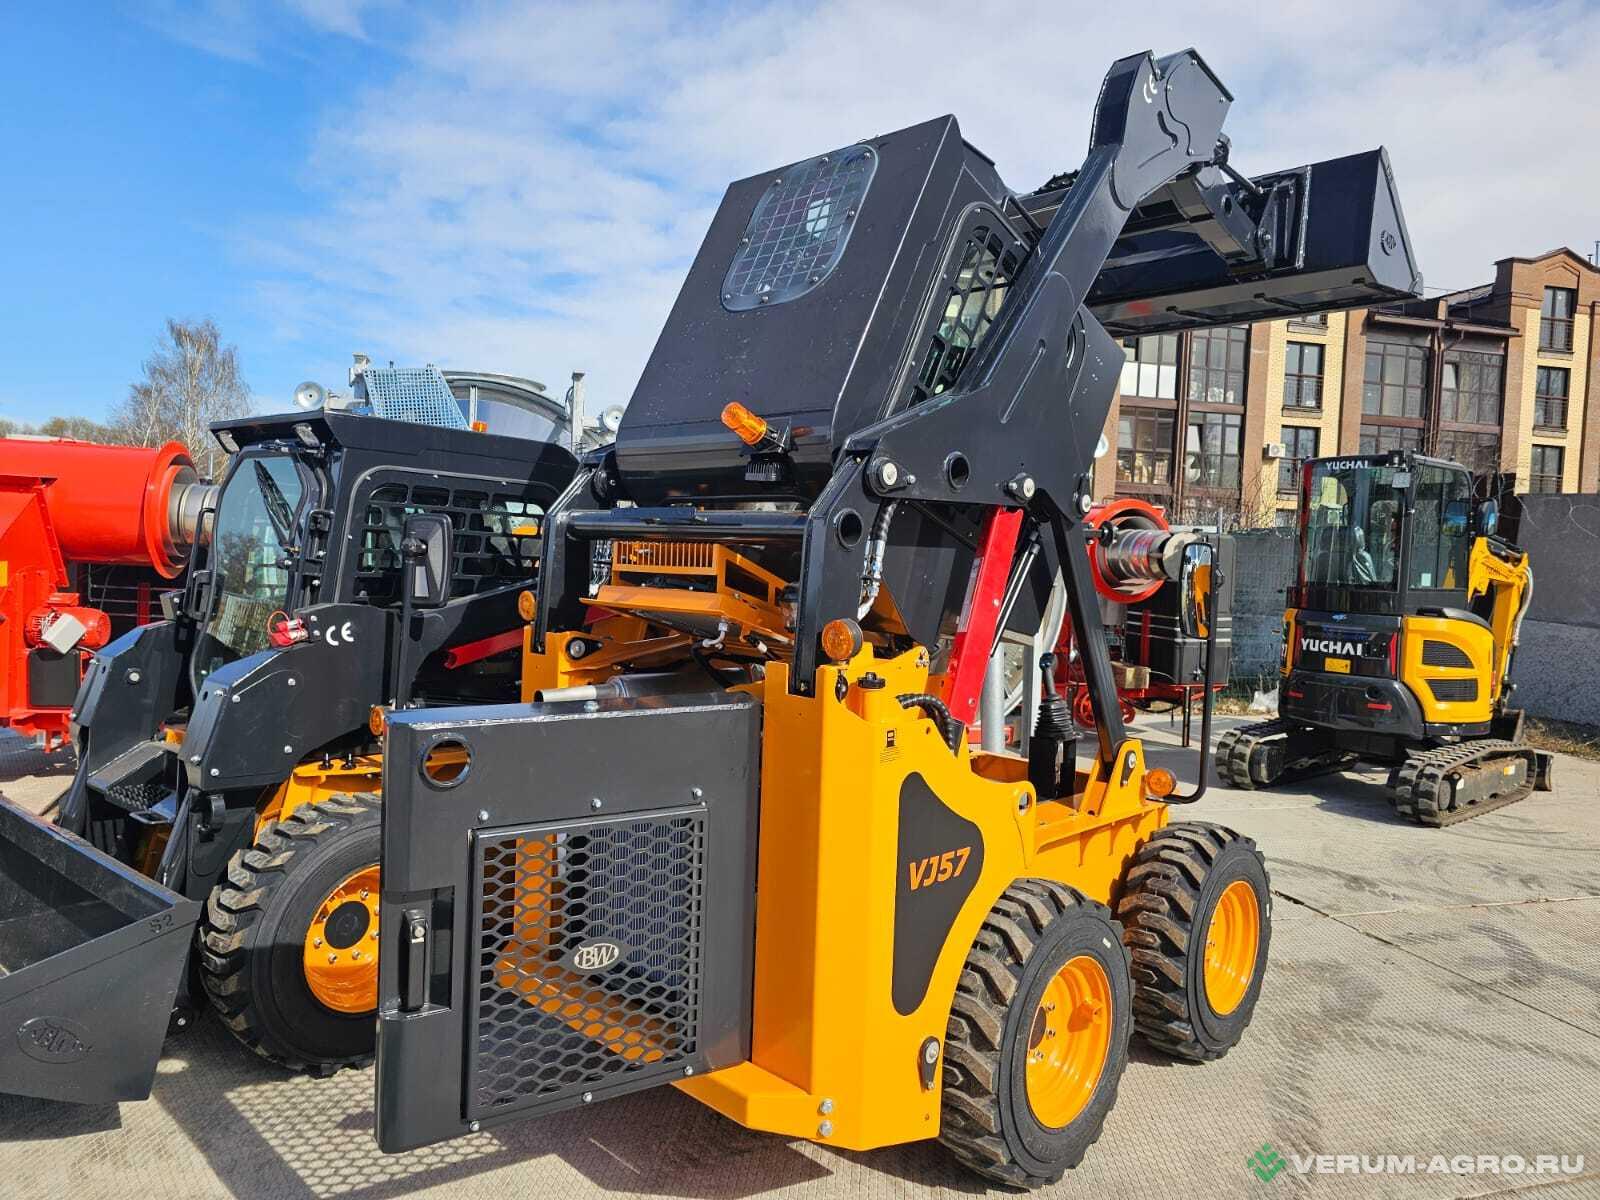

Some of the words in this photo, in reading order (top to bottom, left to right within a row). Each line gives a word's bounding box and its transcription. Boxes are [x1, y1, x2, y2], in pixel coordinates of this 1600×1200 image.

[1326, 460, 1369, 470] YUCHAI
[1301, 638, 1362, 656] YUCHAI
[909, 847, 972, 892] VJ57
[578, 943, 615, 969] BW
